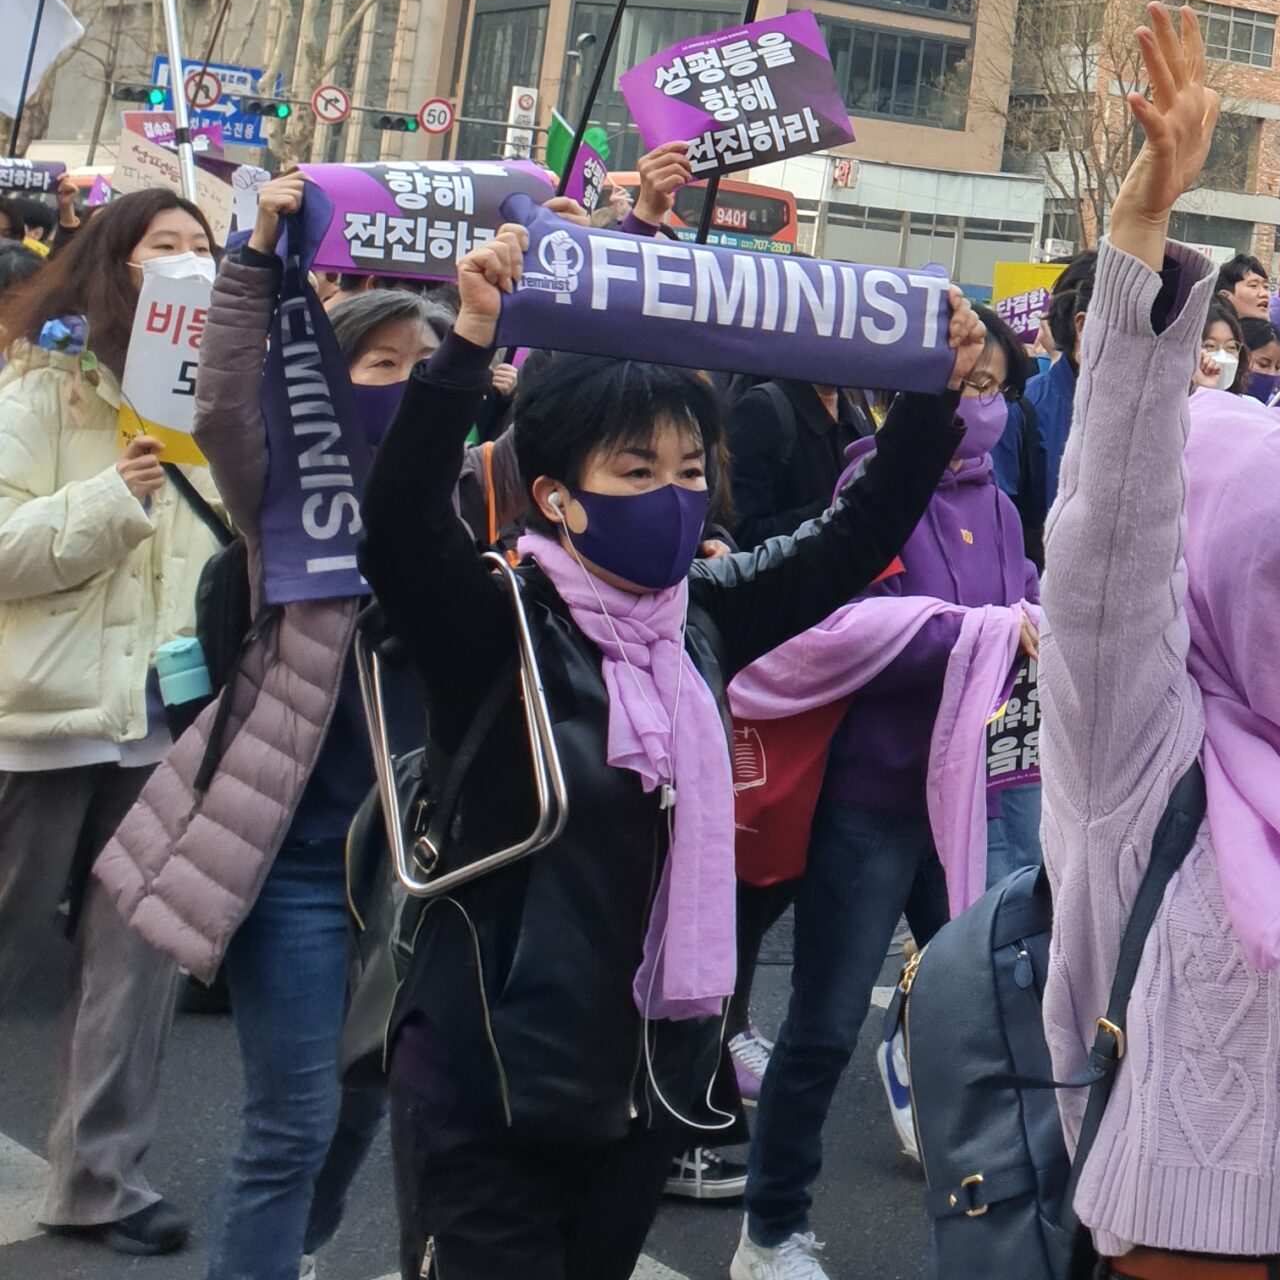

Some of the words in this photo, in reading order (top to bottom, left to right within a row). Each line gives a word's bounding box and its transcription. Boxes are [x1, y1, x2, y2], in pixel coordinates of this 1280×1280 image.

[654, 32, 796, 96] 성평등을
[426, 109, 447, 125] 50
[700, 75, 777, 122] 향해
[685, 106, 820, 173] 전진하라
[385, 170, 475, 215] 향해
[716, 207, 747, 227] 9401
[588, 234, 949, 348] FEMINIST
